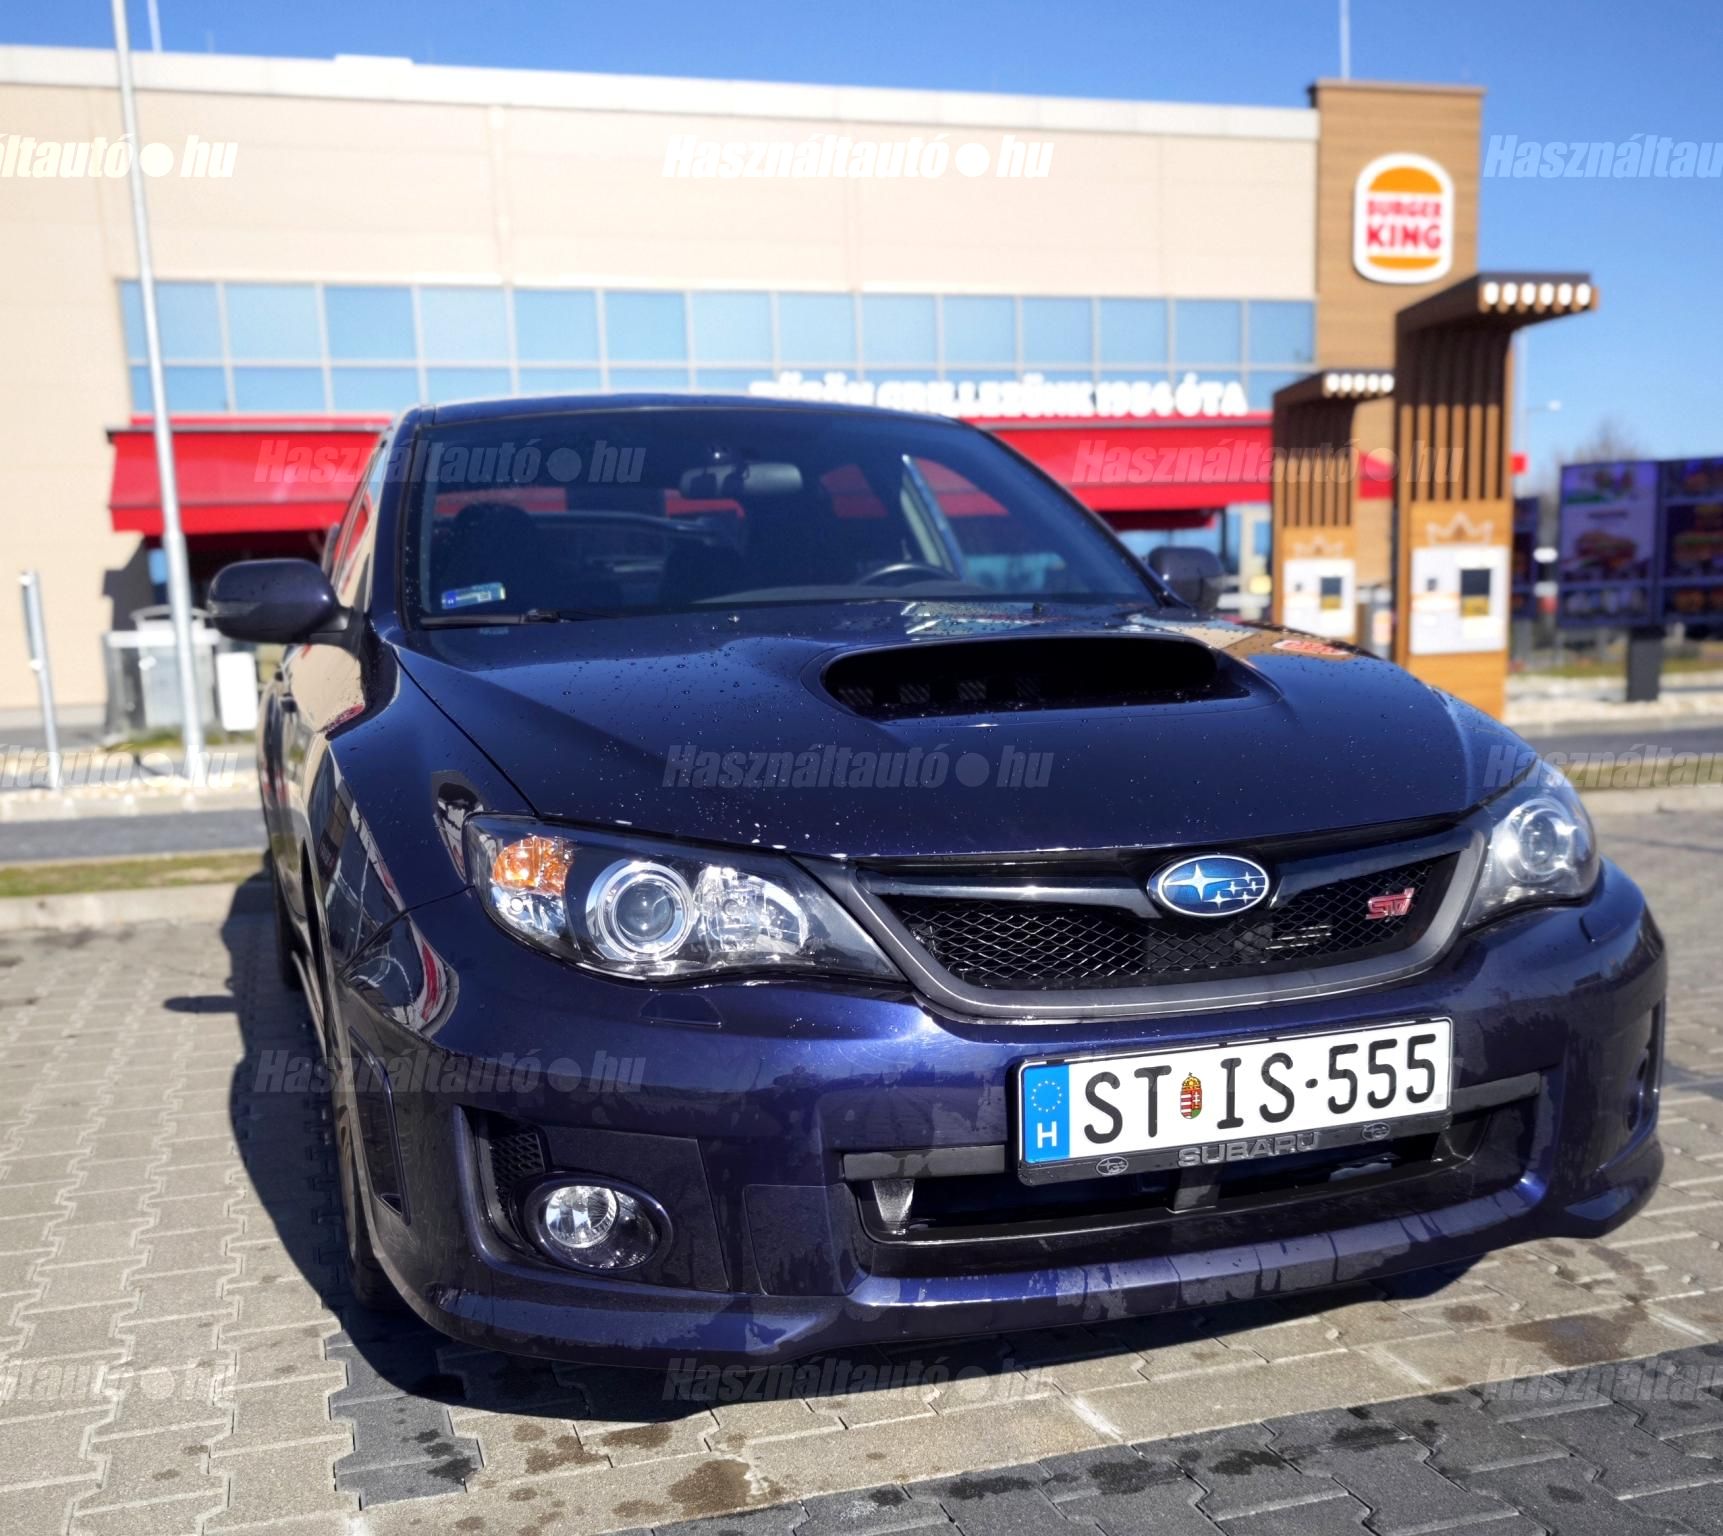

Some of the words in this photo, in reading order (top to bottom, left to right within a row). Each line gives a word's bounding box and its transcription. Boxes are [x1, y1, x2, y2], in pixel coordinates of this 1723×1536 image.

[1366, 223, 1442, 249] KING
[1175, 371, 1248, 417] ÓTA
[1036, 1120, 1058, 1149] H
[1177, 1131, 1320, 1168] SUBARU
